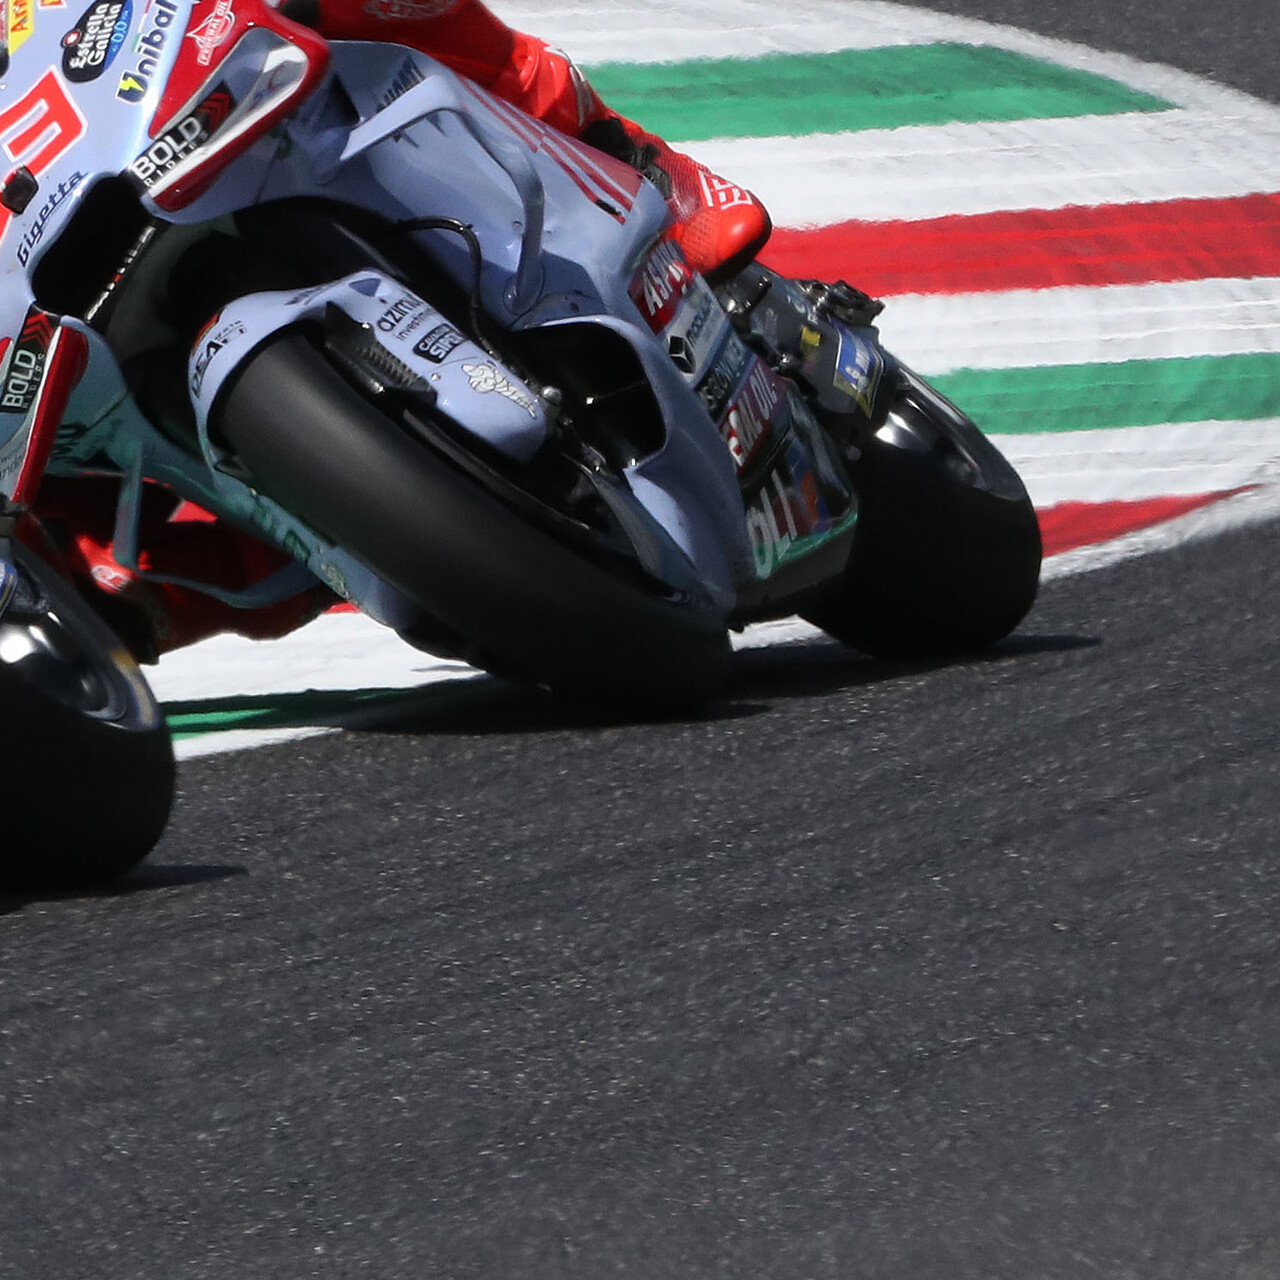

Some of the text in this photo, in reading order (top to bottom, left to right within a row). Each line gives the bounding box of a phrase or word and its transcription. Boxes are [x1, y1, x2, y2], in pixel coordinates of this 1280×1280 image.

[69, 3, 110, 69] Estrella
[87, 4, 123, 66] Galicia
[131, 116, 202, 181] BOLD
[16, 169, 90, 268] Gigetta
[1, 349, 37, 408] BOLD
